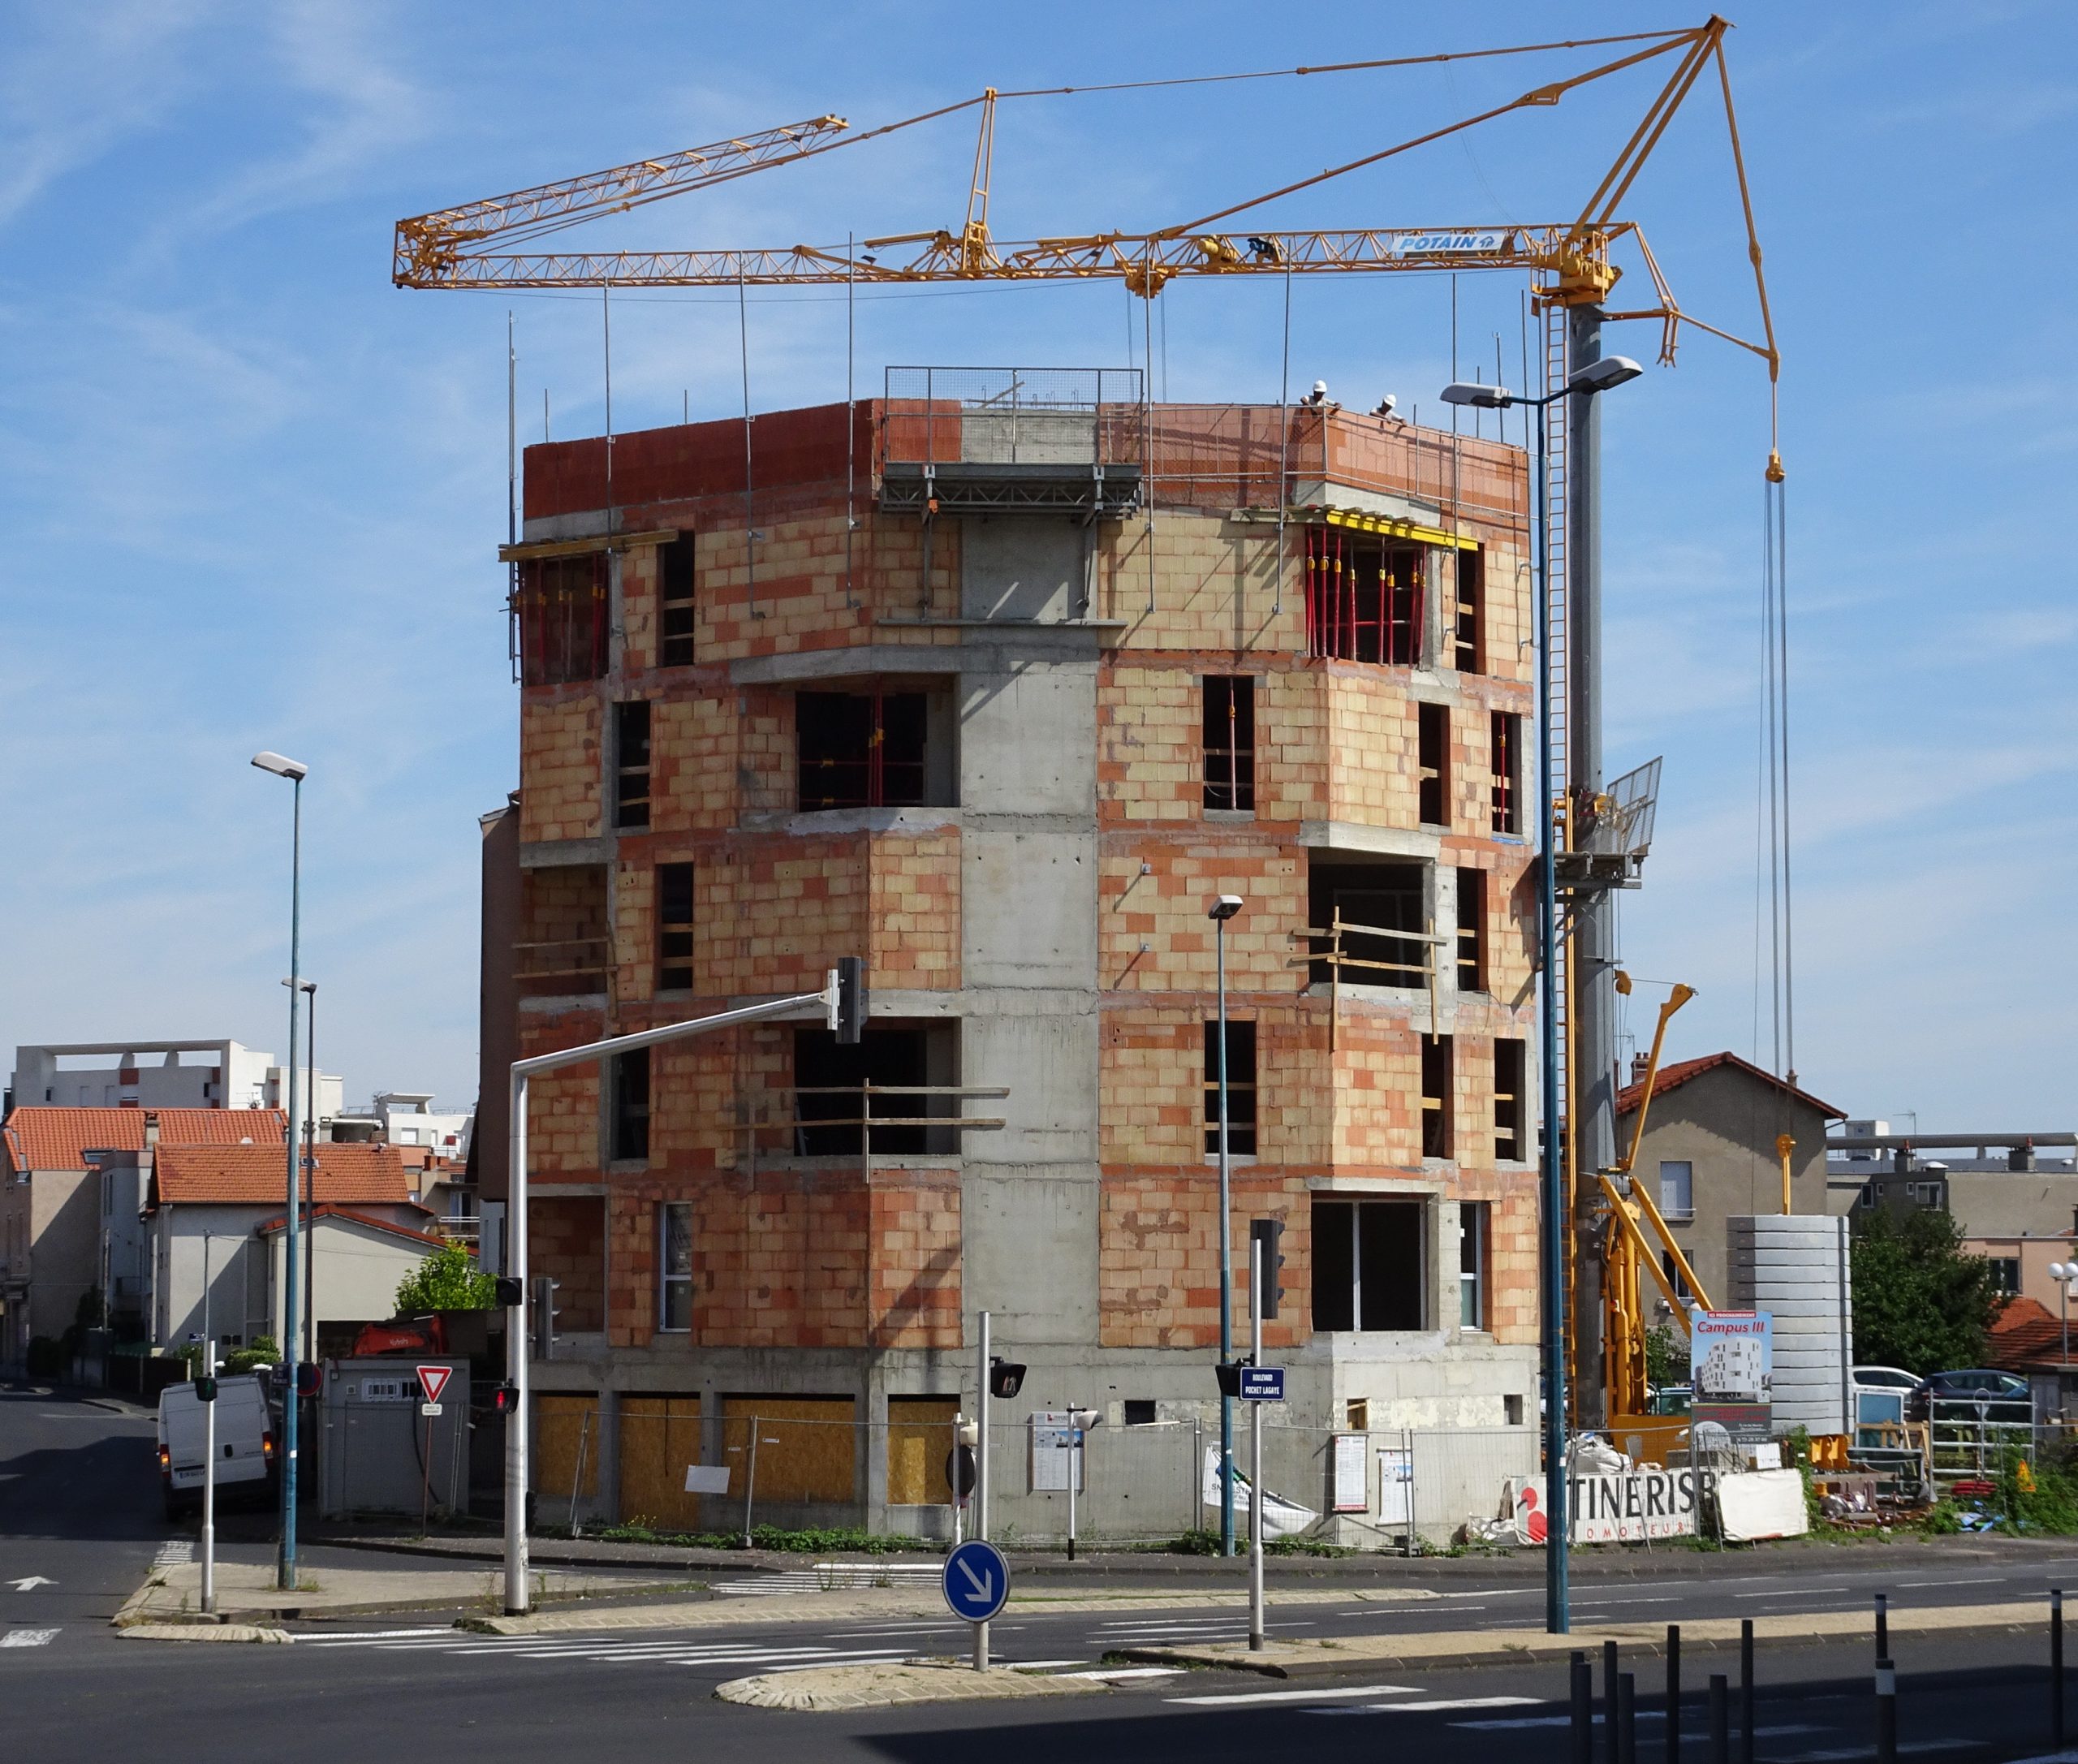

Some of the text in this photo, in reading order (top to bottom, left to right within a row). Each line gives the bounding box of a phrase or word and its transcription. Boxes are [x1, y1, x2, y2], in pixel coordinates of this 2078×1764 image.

[1399, 235, 1477, 250] POTAIN
[1697, 1321, 1765, 1336] Campus III
